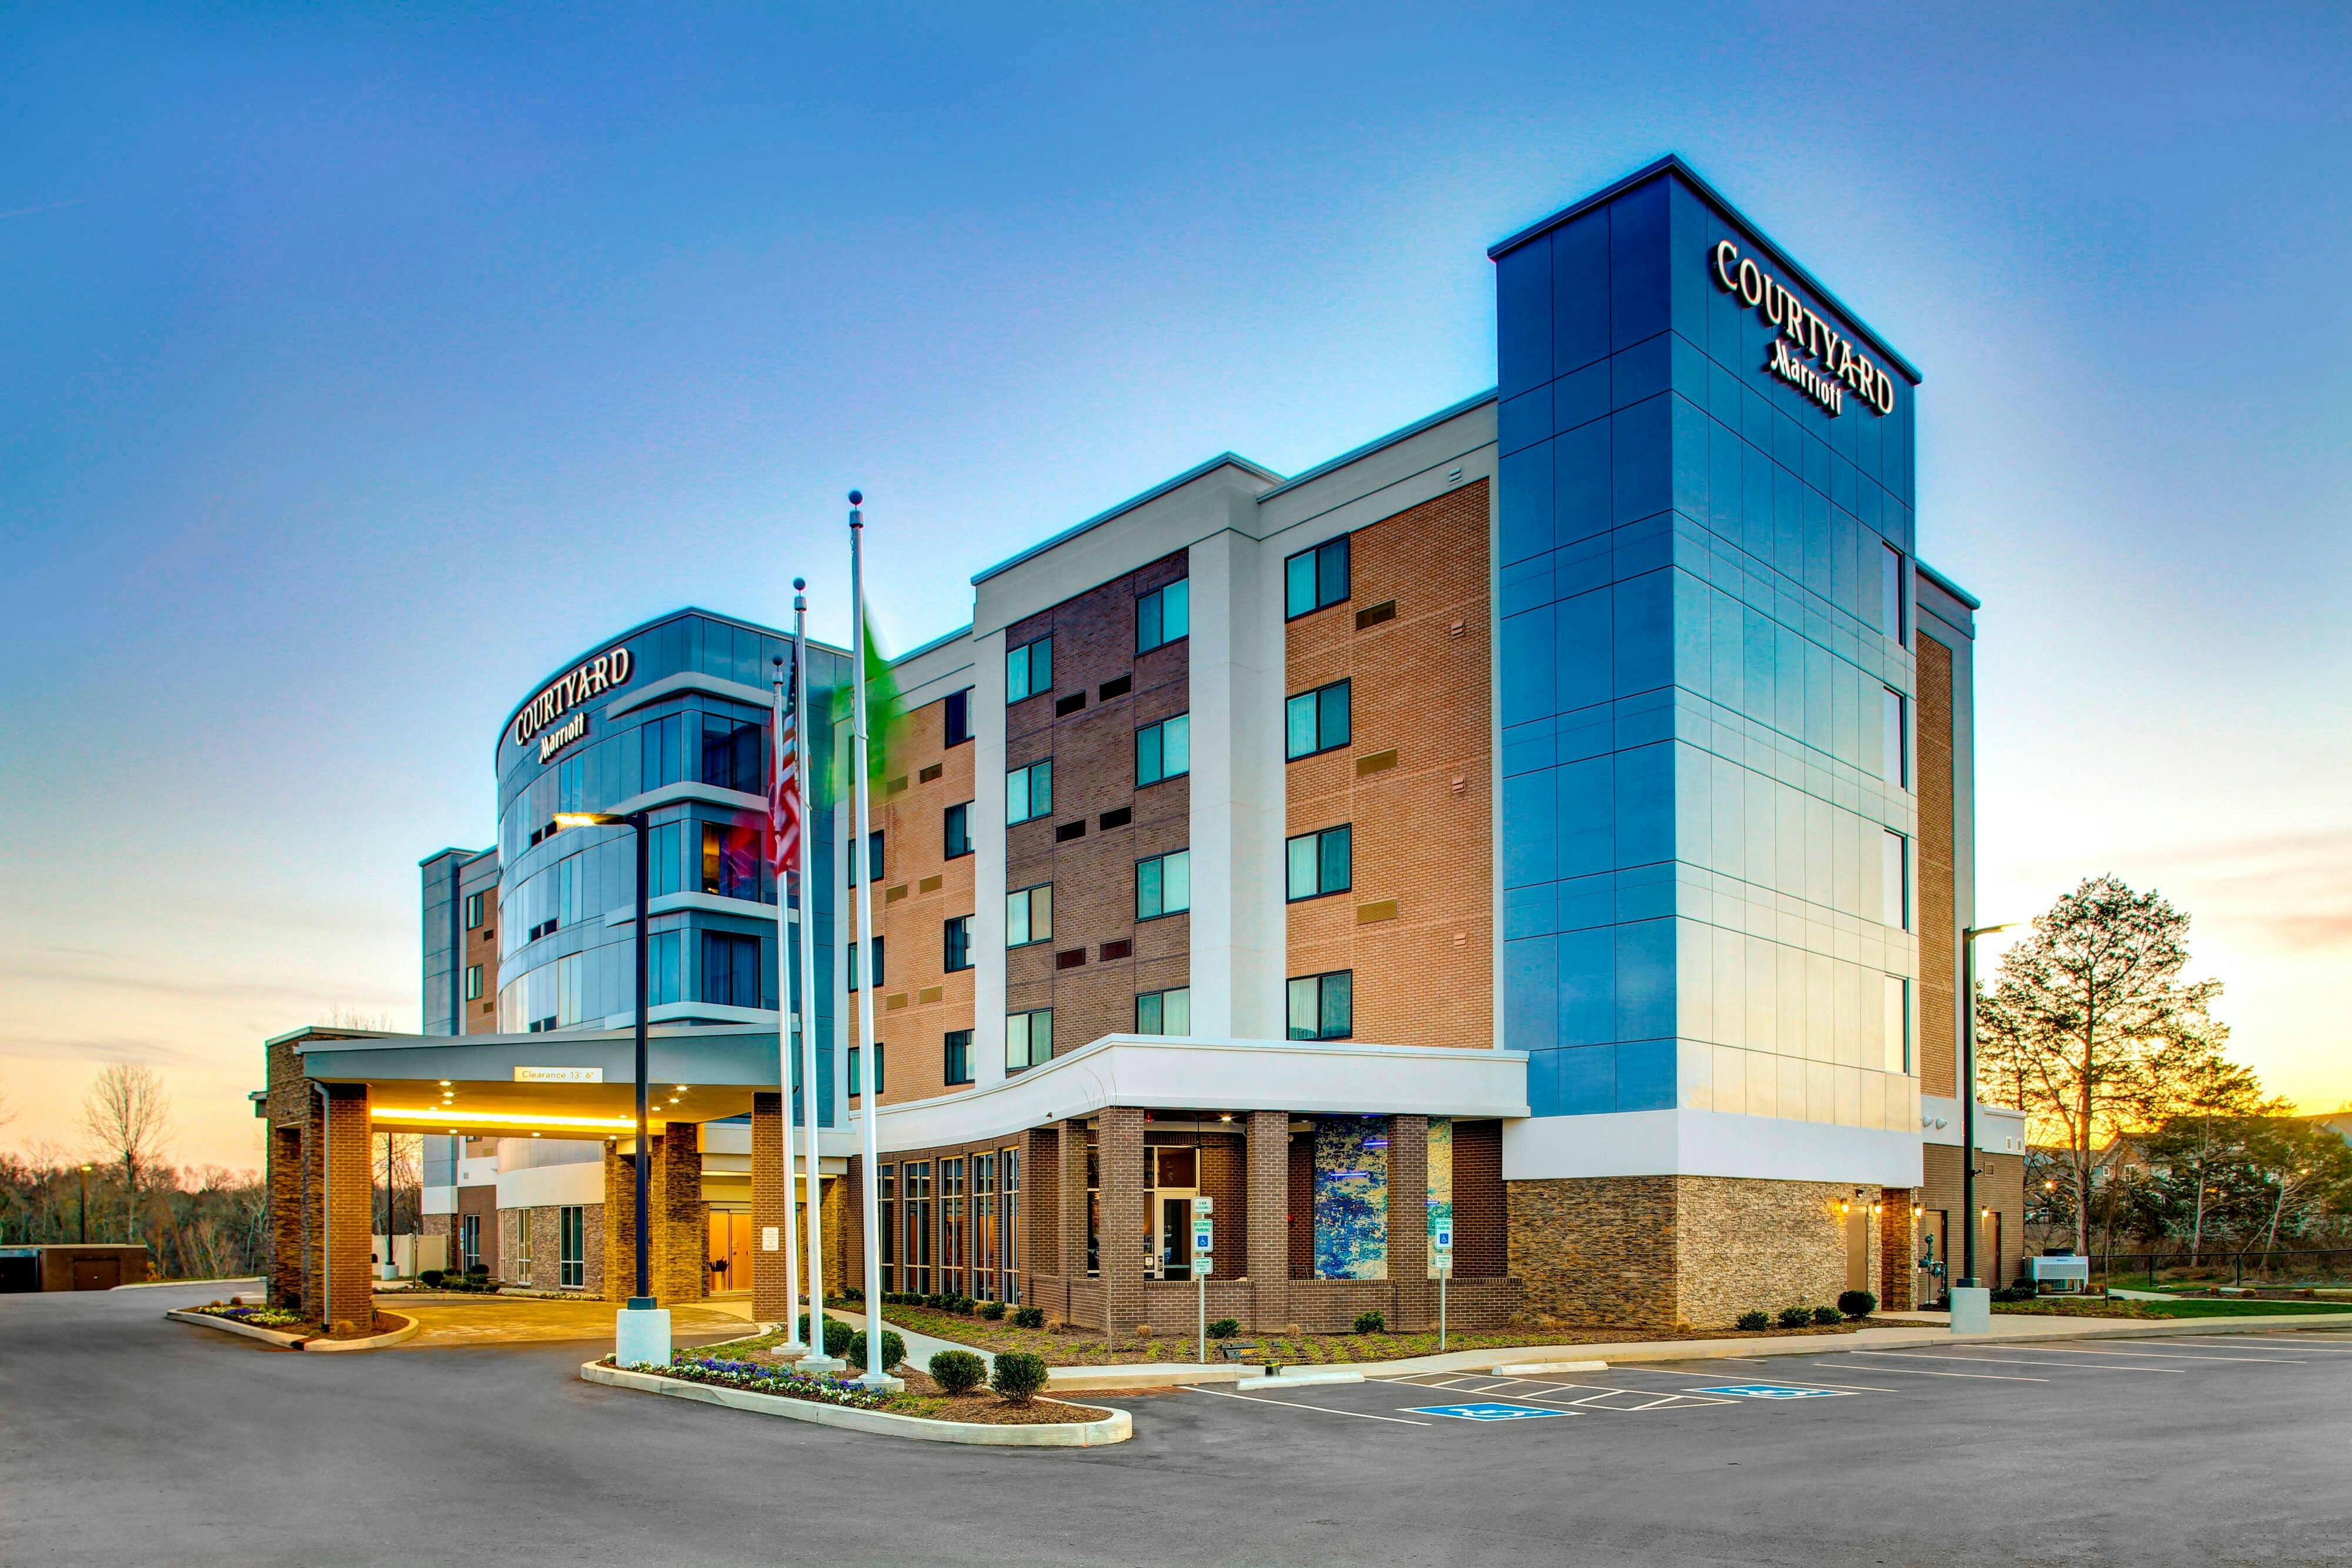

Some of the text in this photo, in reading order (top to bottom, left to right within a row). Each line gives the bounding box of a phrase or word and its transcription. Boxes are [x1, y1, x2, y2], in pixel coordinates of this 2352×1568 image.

[1716, 239, 1894, 415] COURTYARD
[1770, 339, 1842, 416] Marriott
[515, 647, 629, 746] COURTYARD
[539, 711, 584, 764] Marriott
